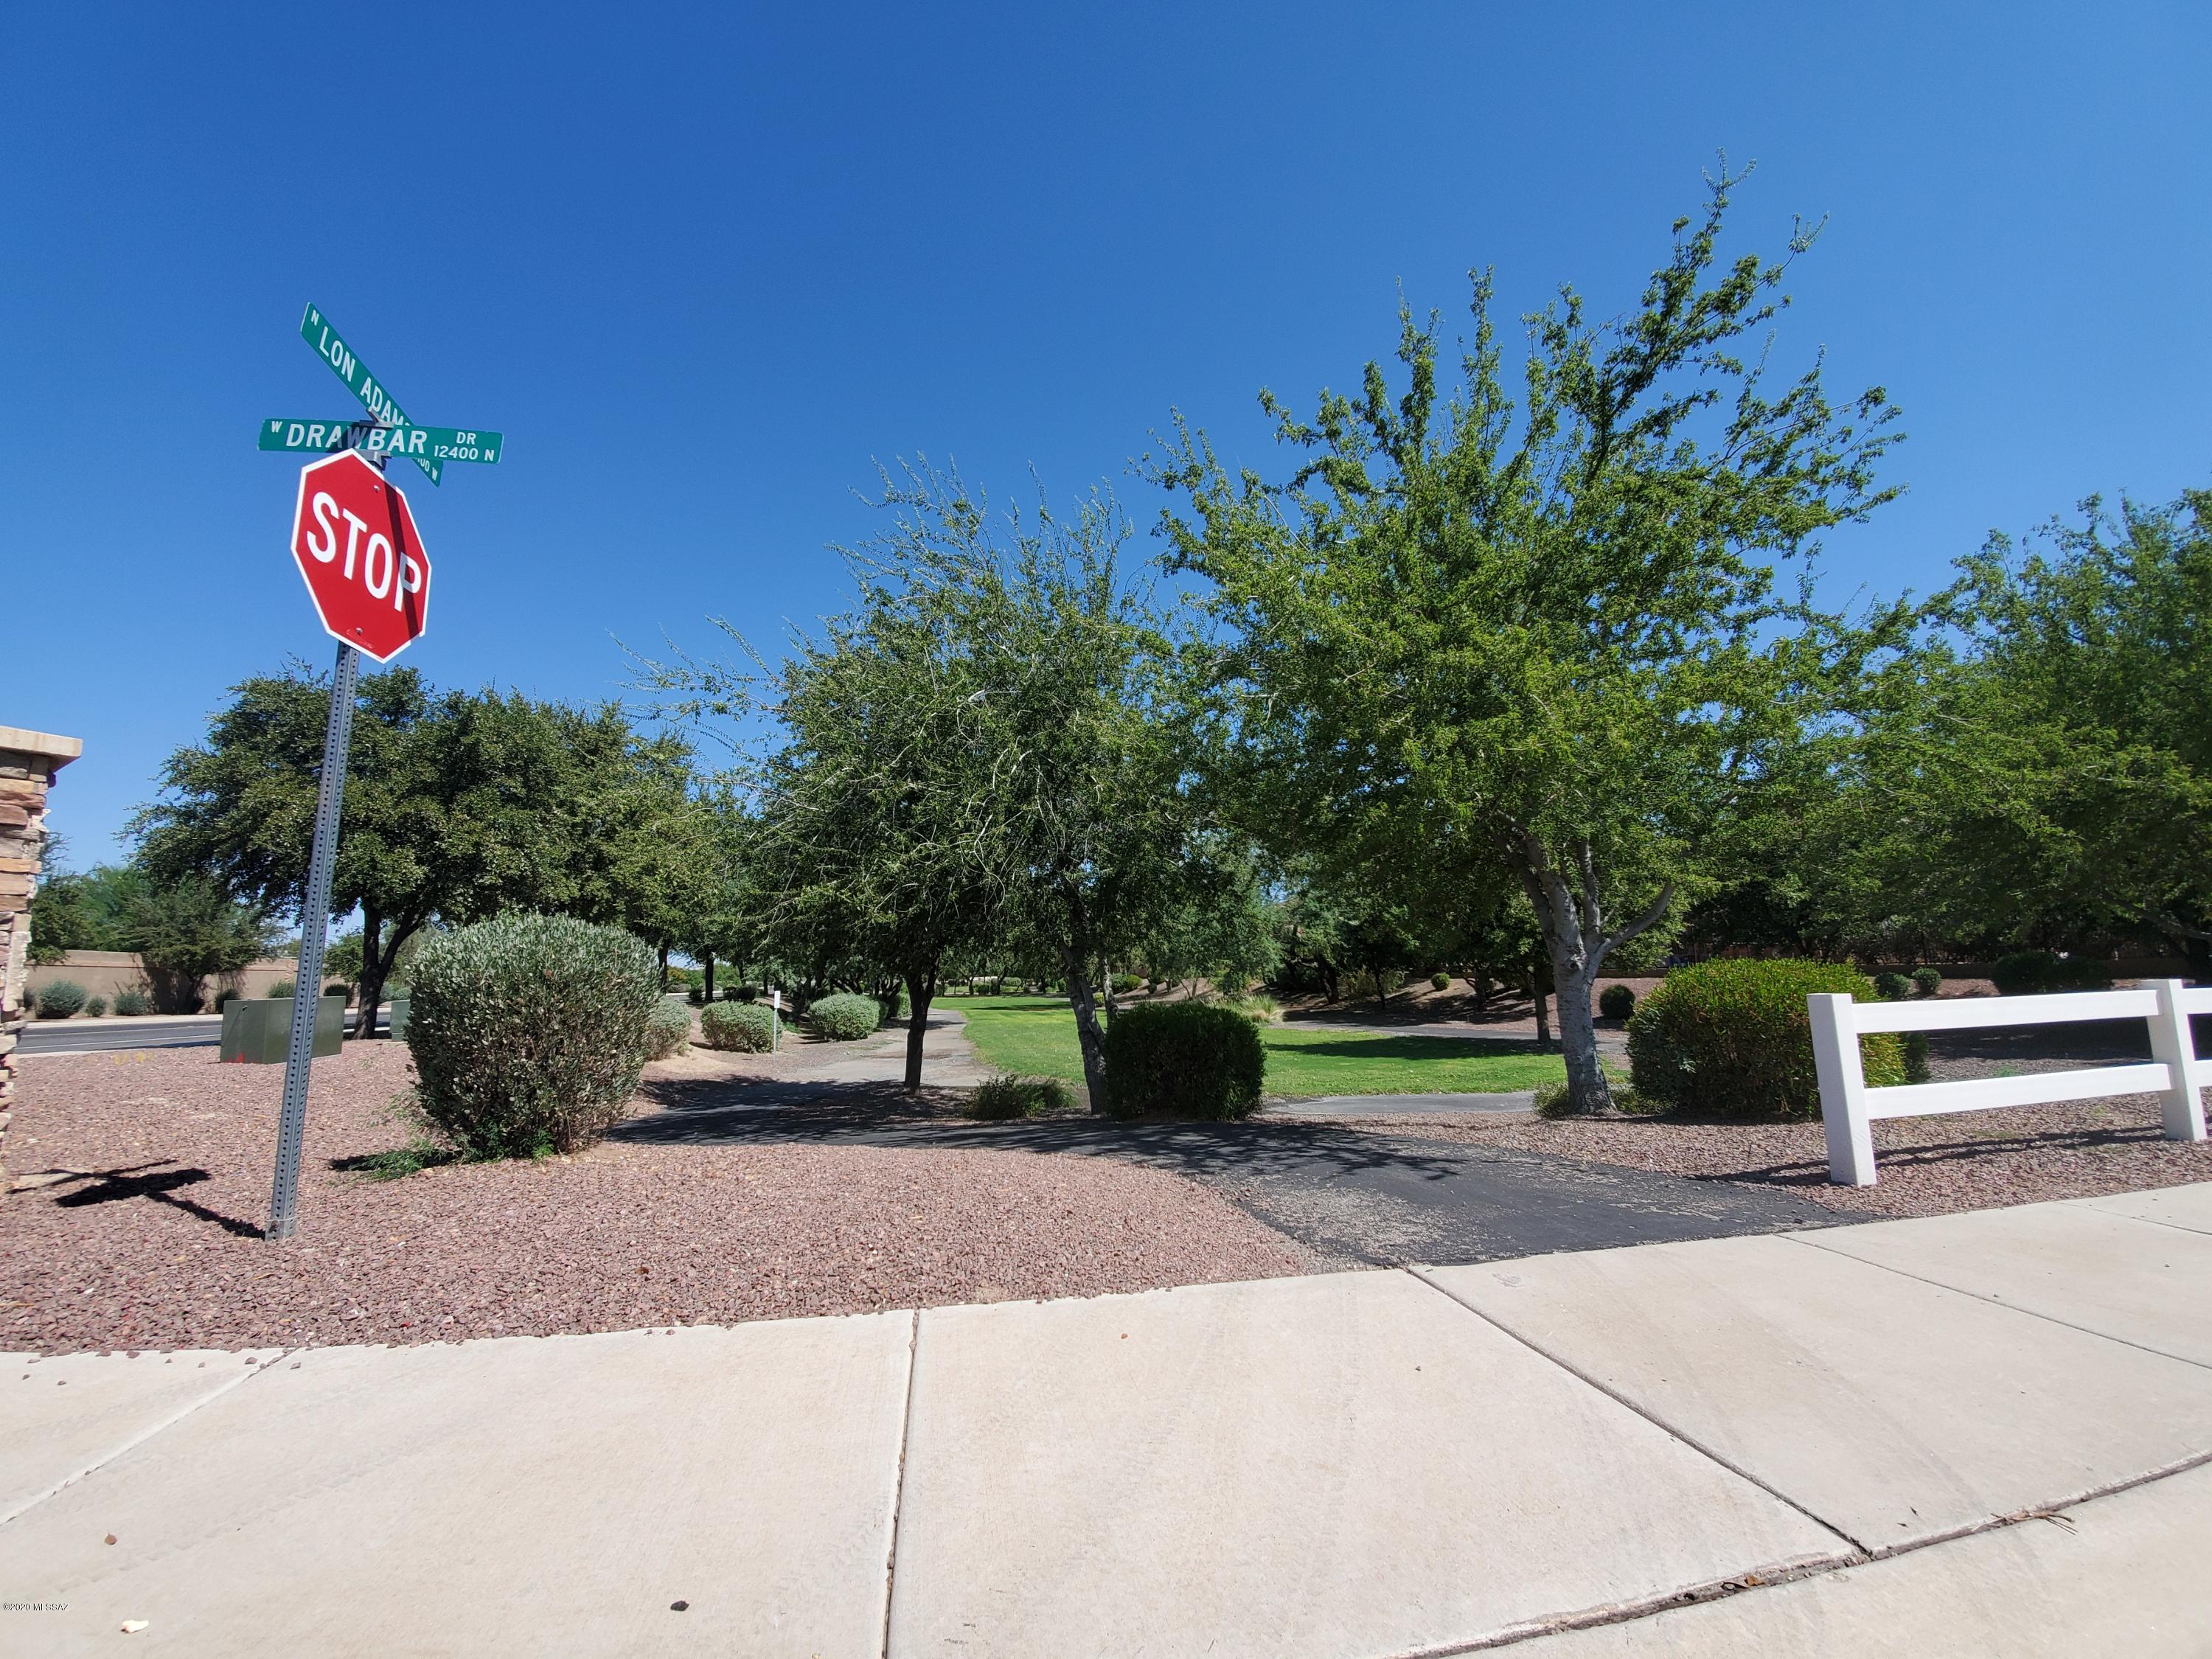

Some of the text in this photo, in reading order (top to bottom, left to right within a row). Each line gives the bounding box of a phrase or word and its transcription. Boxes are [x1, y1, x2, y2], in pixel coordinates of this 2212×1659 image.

[311, 309, 411, 426] N LON ADAM
[271, 421, 476, 454] W DRAWBAR DR
[434, 445, 495, 462] 12400 N
[432, 467, 438, 481] W
[307, 492, 422, 612] STOP
